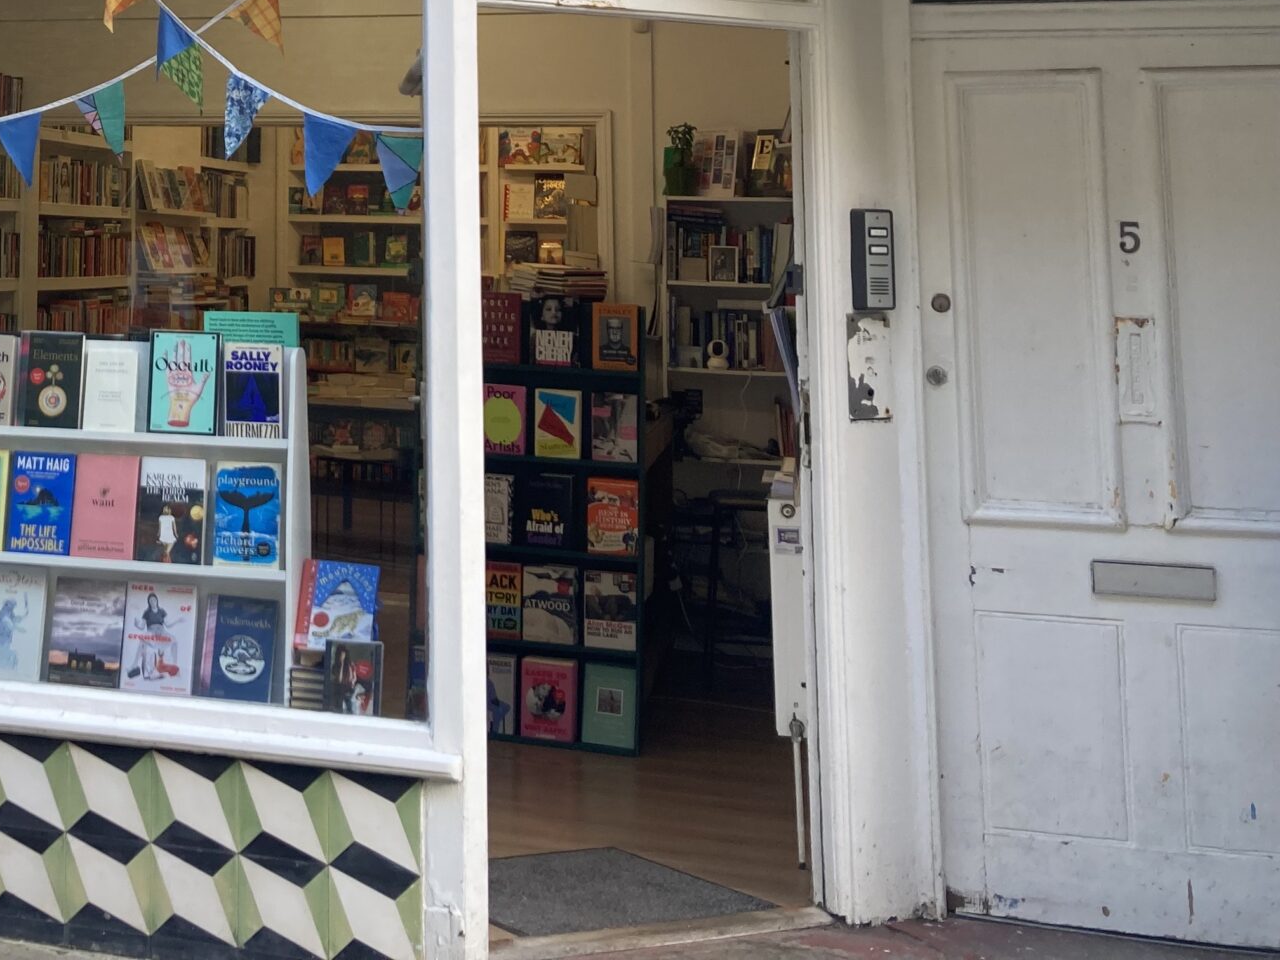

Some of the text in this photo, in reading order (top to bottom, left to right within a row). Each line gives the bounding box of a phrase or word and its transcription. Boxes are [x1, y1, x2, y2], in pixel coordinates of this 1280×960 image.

[1119, 221, 1141, 254] 5
[33, 348, 79, 361] Elements
[230, 350, 272, 361] SALLY
[155, 356, 214, 373] Occult
[225, 361, 279, 372] ROONEY
[487, 386, 516, 399] Poor
[225, 421, 280, 439] INTERMEZZO
[485, 438, 521, 453] Artists
[17, 456, 70, 472] MATT HAIG
[217, 475, 277, 487] playground
[92, 499, 115, 507] want
[531, 508, 559, 522] Who's
[20, 523, 57, 538] THE LIFE
[526, 519, 564, 535] Afraid of
[11, 537, 64, 552] IMPOSSIBLE
[216, 533, 255, 546] richard
[501, 607, 517, 617] DAY
[525, 599, 570, 612] ATWOOD
[220, 615, 271, 629] Underworlds
